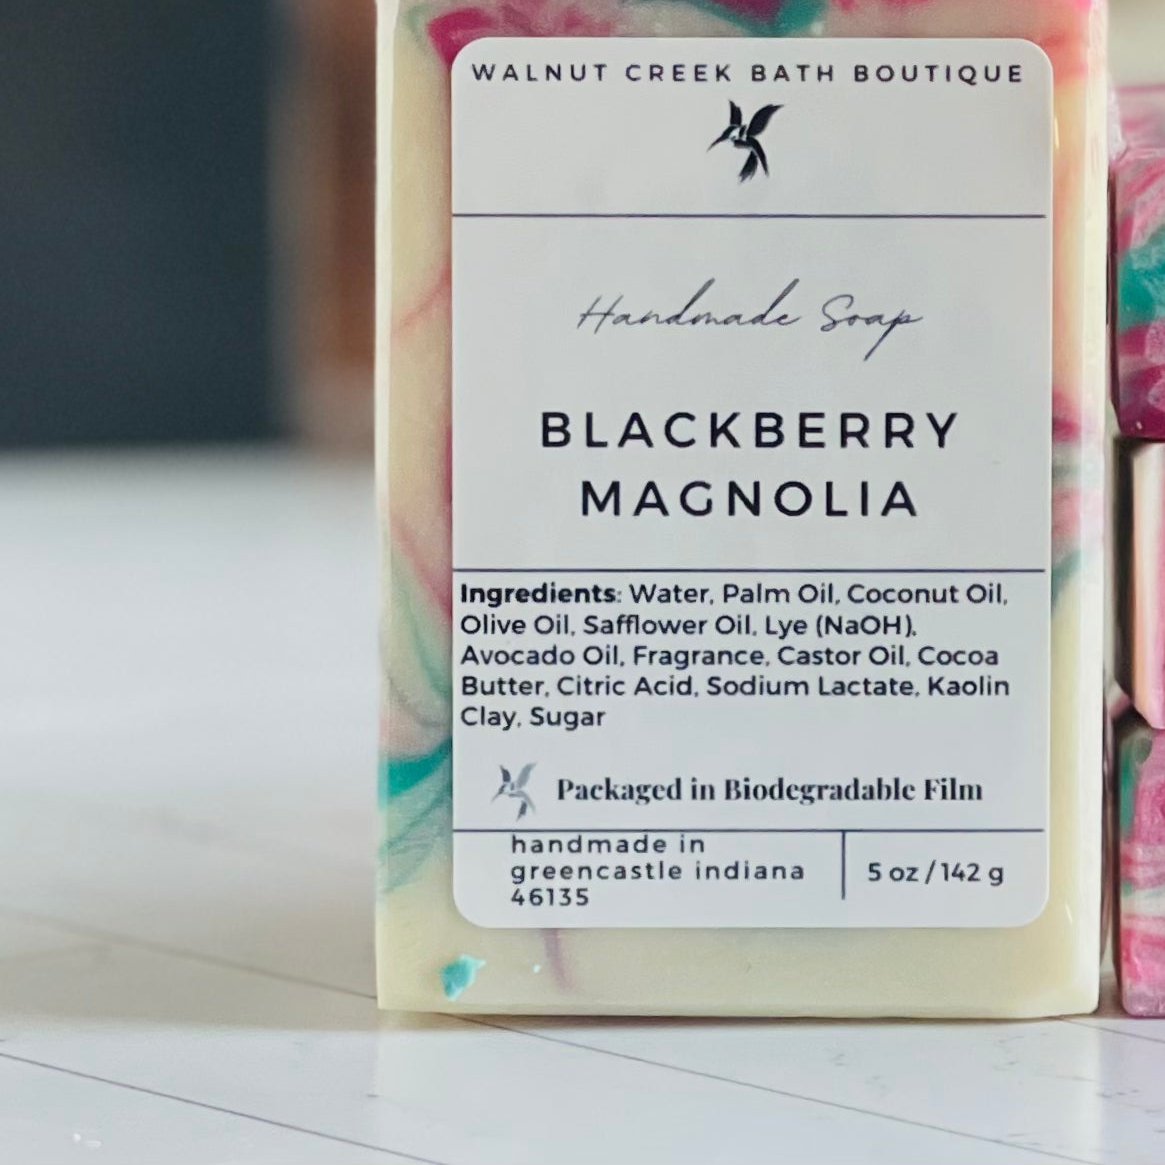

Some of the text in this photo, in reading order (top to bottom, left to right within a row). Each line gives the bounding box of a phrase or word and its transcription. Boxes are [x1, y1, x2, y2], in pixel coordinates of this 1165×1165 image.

[471, 63, 1022, 87] WALNUT CREEK BATH BOUTIQUE
[576, 277, 924, 362] Handmade Soap
[541, 411, 958, 449] BLACKBERRY
[581, 479, 918, 518] MAGNOLIA
[460, 581, 1008, 609] Ingredients: Water, Palm Oil, Coconut Oil,
[460, 613, 527, 636] Olive
[533, 613, 576, 637] Oil,
[582, 613, 709, 636] Safflower
[714, 613, 758, 637] Oil,
[765, 614, 809, 640] Lye
[459, 643, 999, 671] Avocado Oil, Fragrance, Castor Oil, Cocoa
[461, 674, 1010, 698] Butter, Citric Acid, Sodium Lactate, Kaolin
[460, 705, 607, 732] Clay, Sugar
[557, 776, 983, 806] Packaged in Biodegradable Film
[511, 833, 705, 854] handmade in
[510, 860, 805, 886] greencastle indiana
[868, 861, 883, 882] 5
[987, 866, 1004, 887] g
[510, 887, 589, 907] 46135
